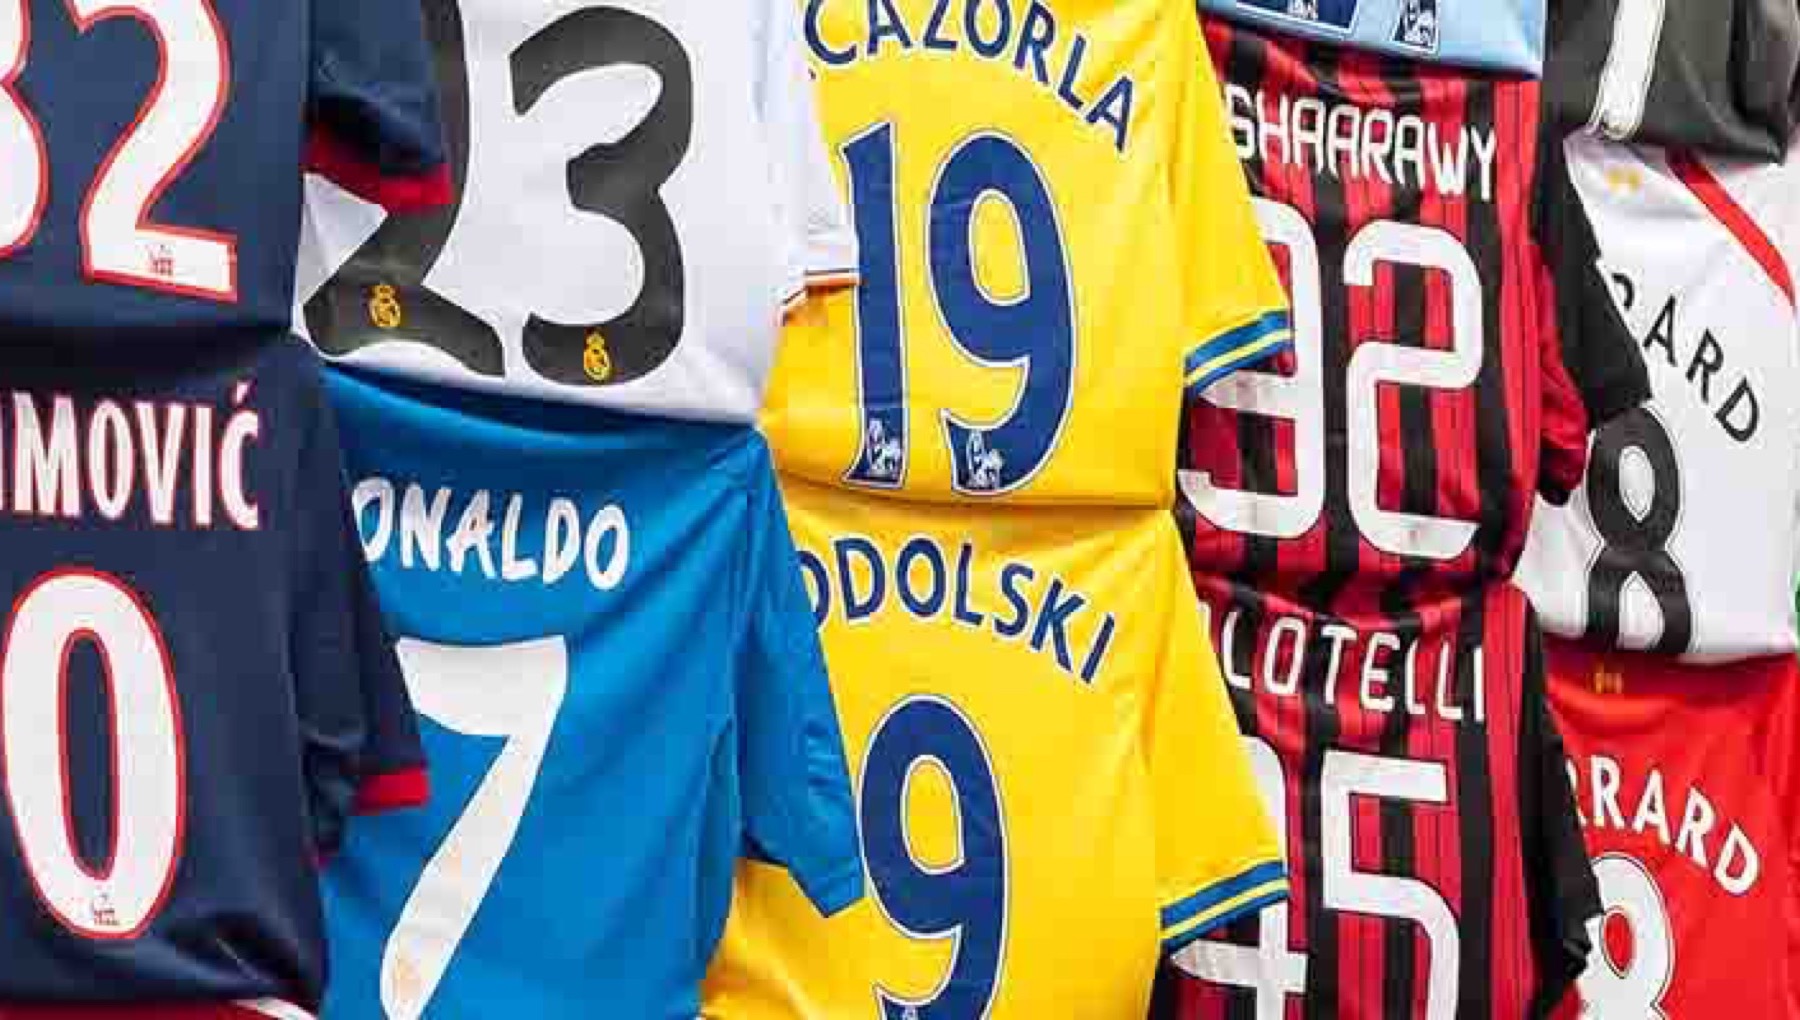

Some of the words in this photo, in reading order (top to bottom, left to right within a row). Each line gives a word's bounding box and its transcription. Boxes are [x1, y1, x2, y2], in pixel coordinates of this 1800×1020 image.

[302, 0, 693, 386] 23
[1224, 82, 1497, 202] SHAARAWY
[0, 379, 259, 533] MOVIĆ
[838, 118, 1077, 496] 19
[1177, 195, 1484, 560] 92
[1197, 600, 1486, 723] LOTELLI
[1585, 402, 1694, 657] 8
[0, 565, 187, 939] 0
[380, 634, 569, 1020] 7
[856, 693, 1010, 1020] 9
[1171, 735, 1461, 1020] 45
